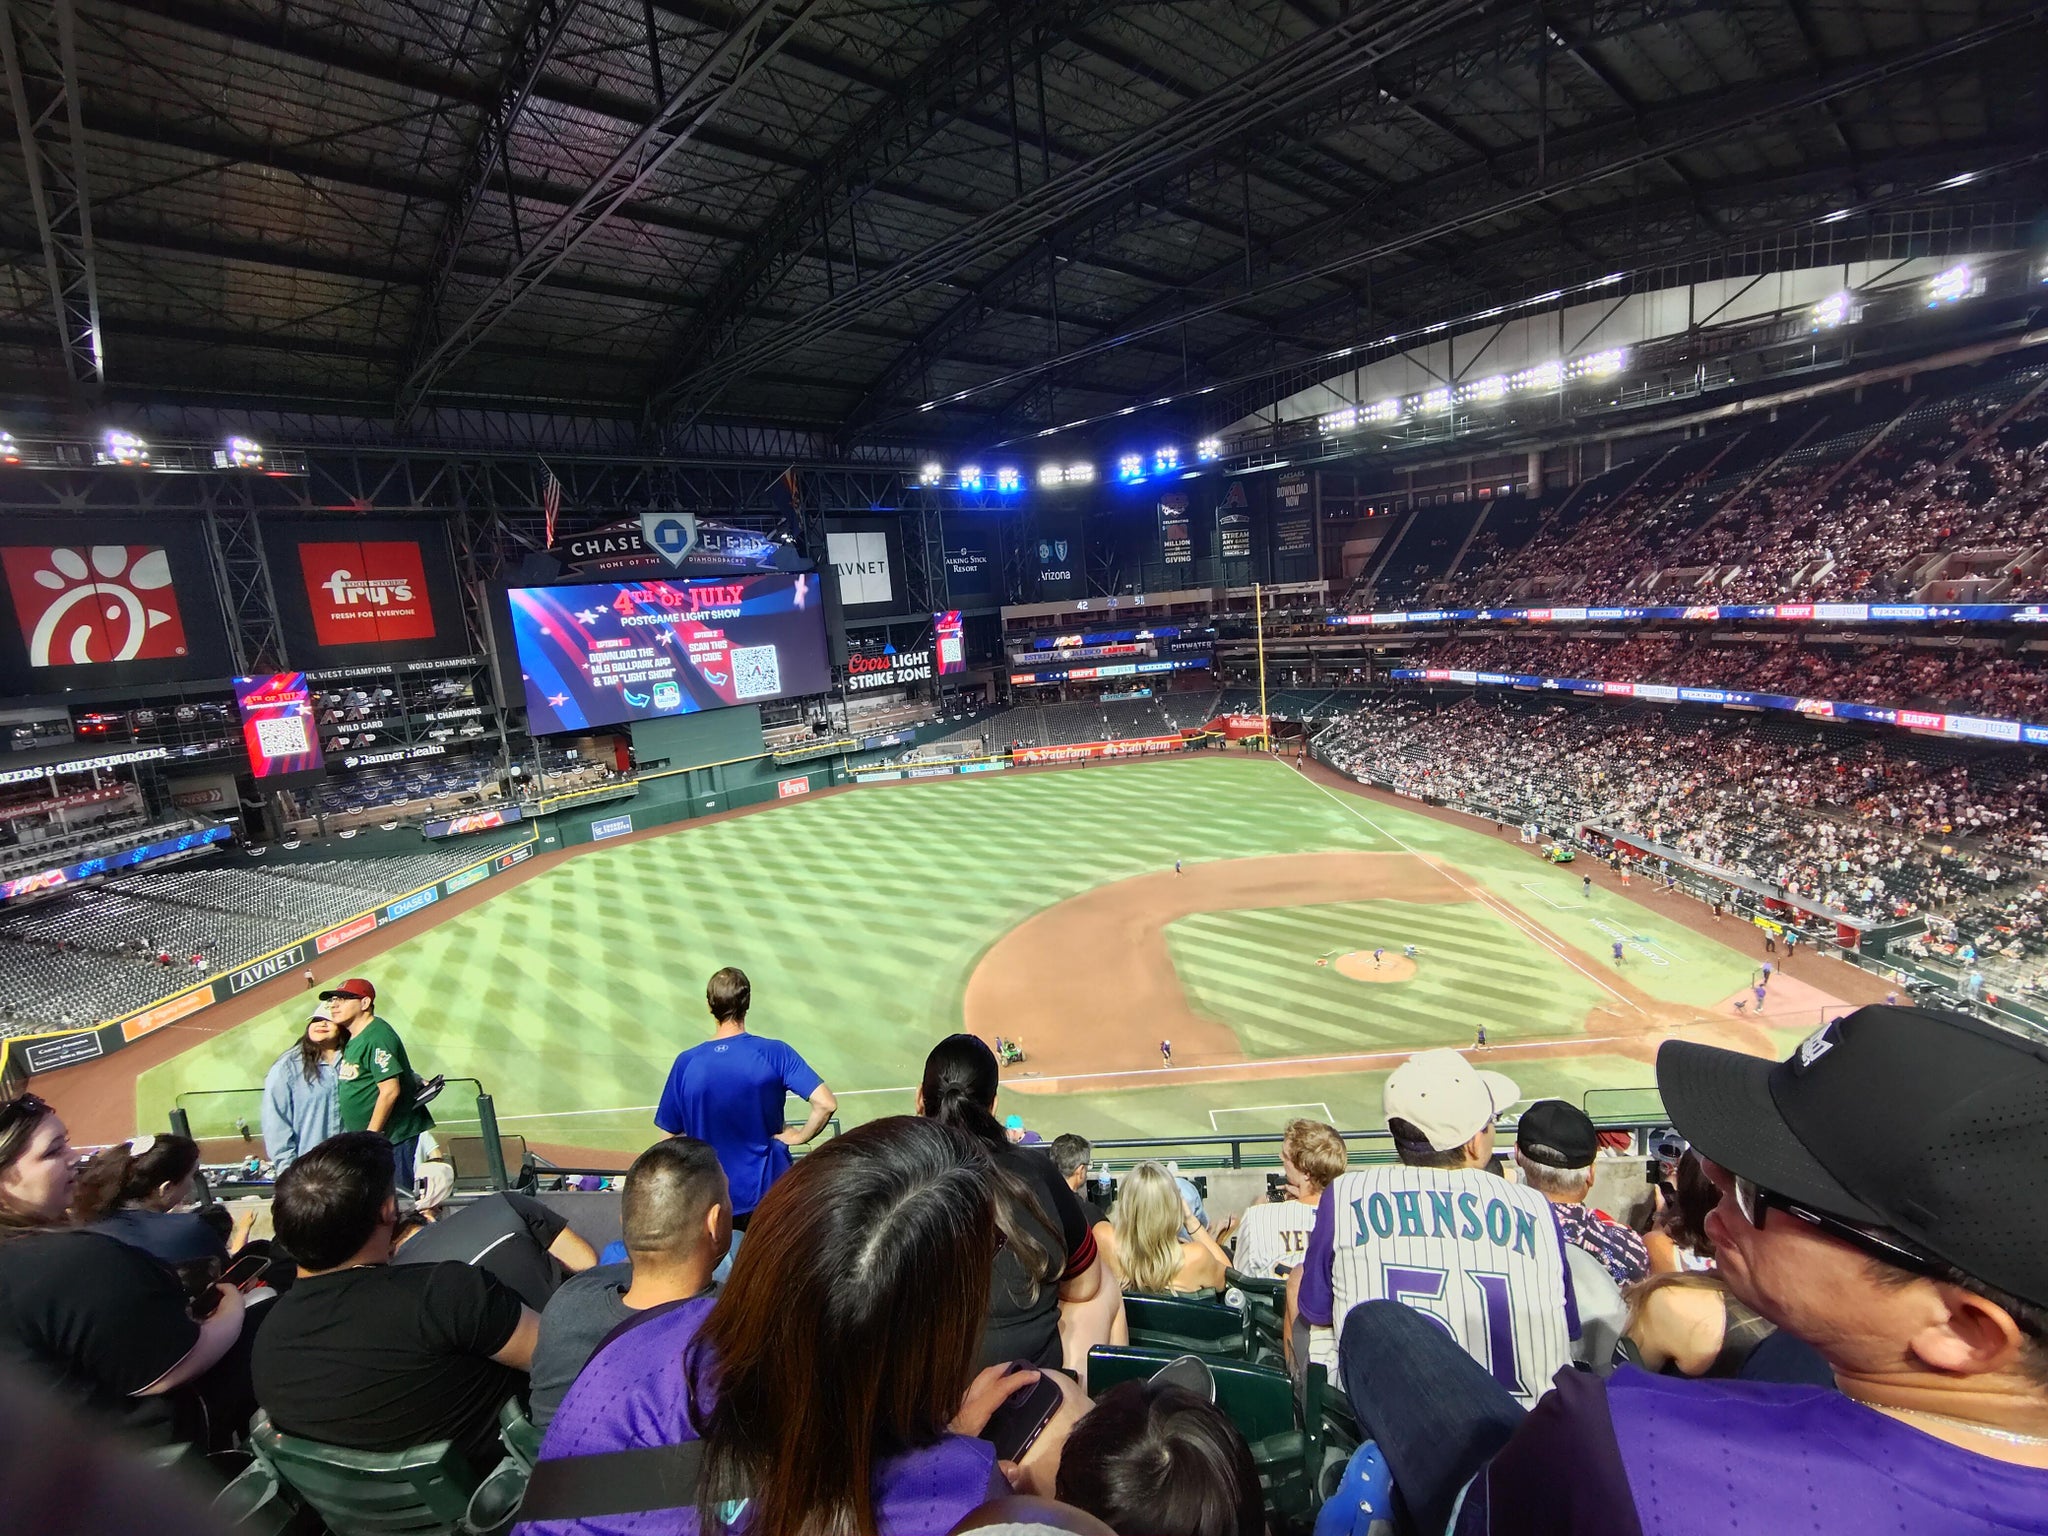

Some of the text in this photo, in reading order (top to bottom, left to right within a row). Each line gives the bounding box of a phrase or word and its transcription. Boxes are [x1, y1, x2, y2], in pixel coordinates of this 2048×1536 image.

[1277, 483, 1309, 498] DOWNLOAD
[1285, 496, 1300, 507] NOW
[1222, 532, 1249, 540] STREAM
[571, 536, 641, 556] CHASE
[322, 569, 413, 606] fry's
[613, 586, 744, 615] 4TH OF JULY
[1077, 601, 1088, 610] 42
[1134, 596, 1145, 605] 51
[331, 609, 415, 620] FRESH FOR EVERYONE
[621, 609, 741, 627] POSTGAME LIGHT SHOW
[1781, 607, 1811, 616] HAPPY
[1871, 607, 1925, 617] WEEKEND
[689, 640, 727, 652] SCAN THIS
[1102, 646, 1136, 655] CANTINA
[1171, 641, 1212, 652] CUTWATER
[590, 648, 654, 662] DOWNLOAD THE
[690, 652, 722, 664] QR CODE
[408, 658, 477, 670] WORLD CHAMPIONS
[592, 657, 671, 674] MLB BALLPARK APP
[848, 652, 929, 674] Coors LIGHT
[319, 671, 344, 679] WEST
[345, 666, 393, 677] CHAMPIONS
[849, 666, 932, 690] STRIKE ZONE
[593, 677, 602, 687] &
[602, 676, 618, 685] TAP
[426, 708, 482, 722] NL CHAMPIONS
[337, 720, 383, 733] WILD CARD
[1903, 714, 1941, 726] HAPPY
[1985, 722, 2013, 735] JULY
[45, 766, 56, 777] &
[57, 747, 168, 774] CHEESEBURGERS
[360, 750, 405, 766] Banner
[393, 897, 424, 915] CHASE
[240, 950, 298, 988] AVNET
[1350, 1191, 1537, 1260] JOHNSON
[1280, 1231, 1312, 1253] YE
